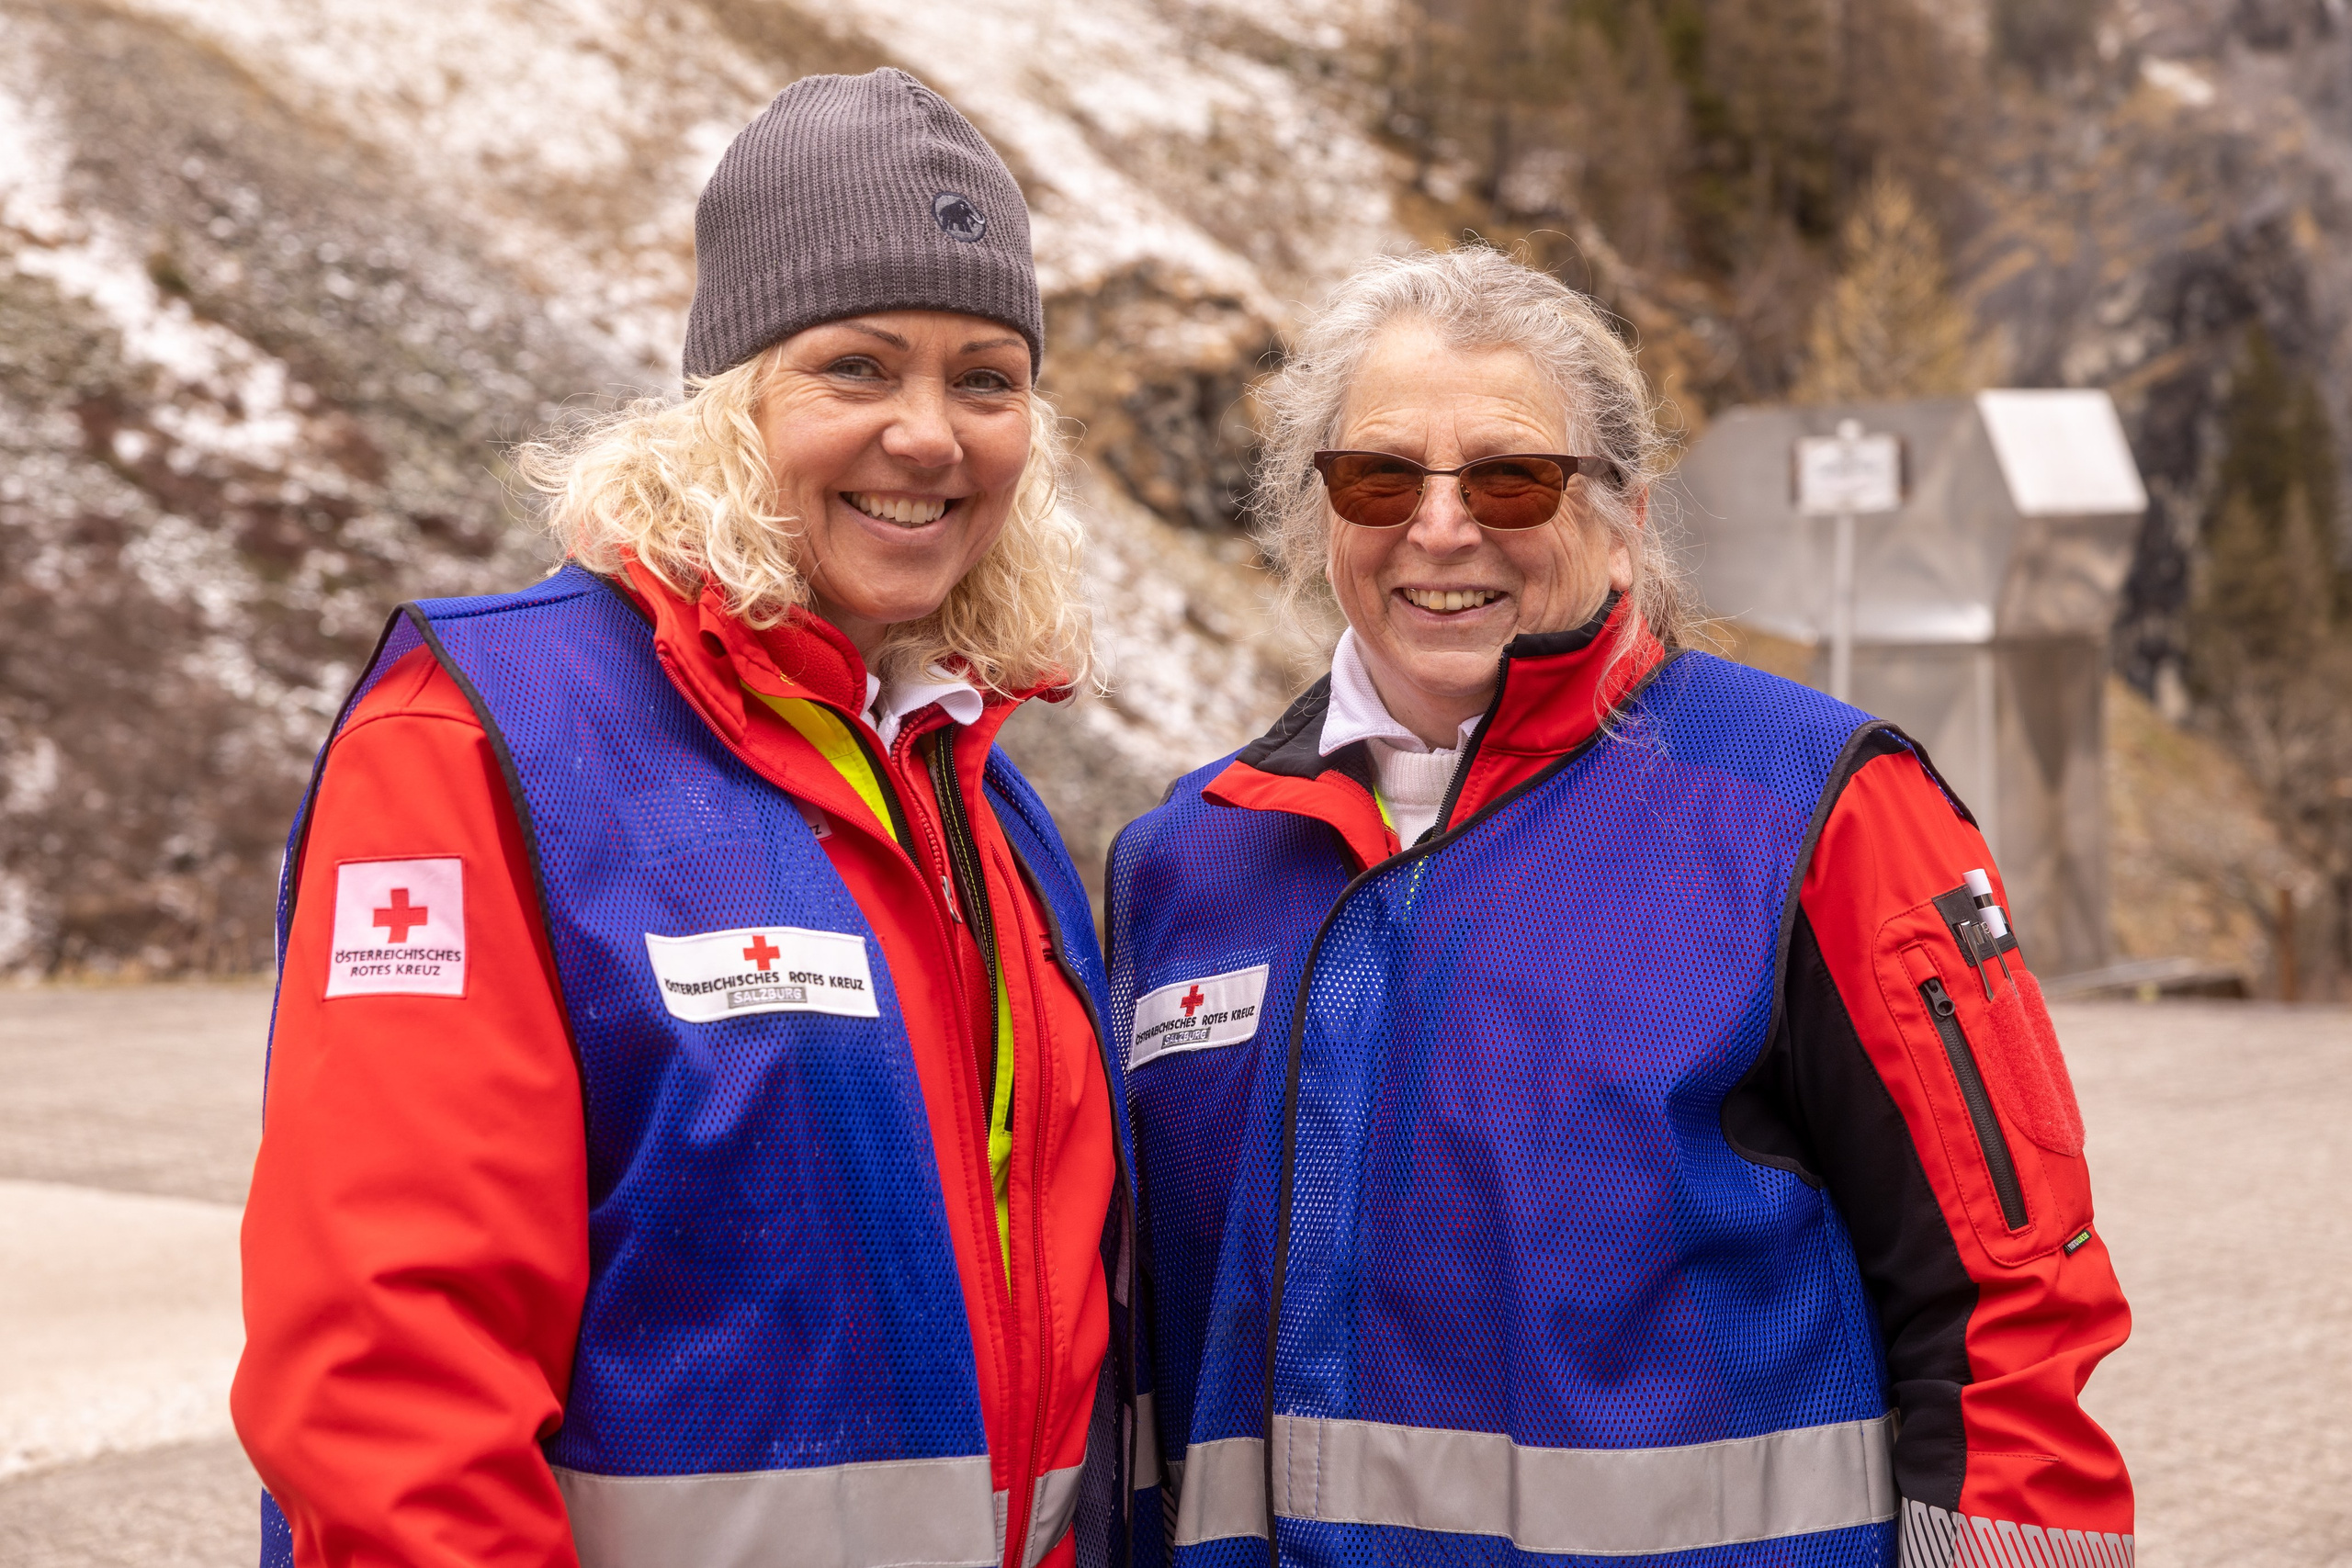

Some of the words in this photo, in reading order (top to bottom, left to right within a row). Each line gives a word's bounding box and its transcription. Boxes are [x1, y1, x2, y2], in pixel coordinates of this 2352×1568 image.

[335, 948, 461, 964] ÖSTERREICHISCHES
[350, 964, 390, 977] ROTES
[395, 964, 440, 976] KREUZ
[664, 972, 779, 996] ÖSTERREICHISCHES
[789, 971, 824, 987] ROTES
[830, 976, 865, 990] KREUZ
[733, 987, 802, 1004] SALZBURG
[1202, 1011, 1227, 1025] ROTES
[1231, 1005, 1255, 1021] KREUZ
[1164, 1029, 1207, 1045] SALZBURG
